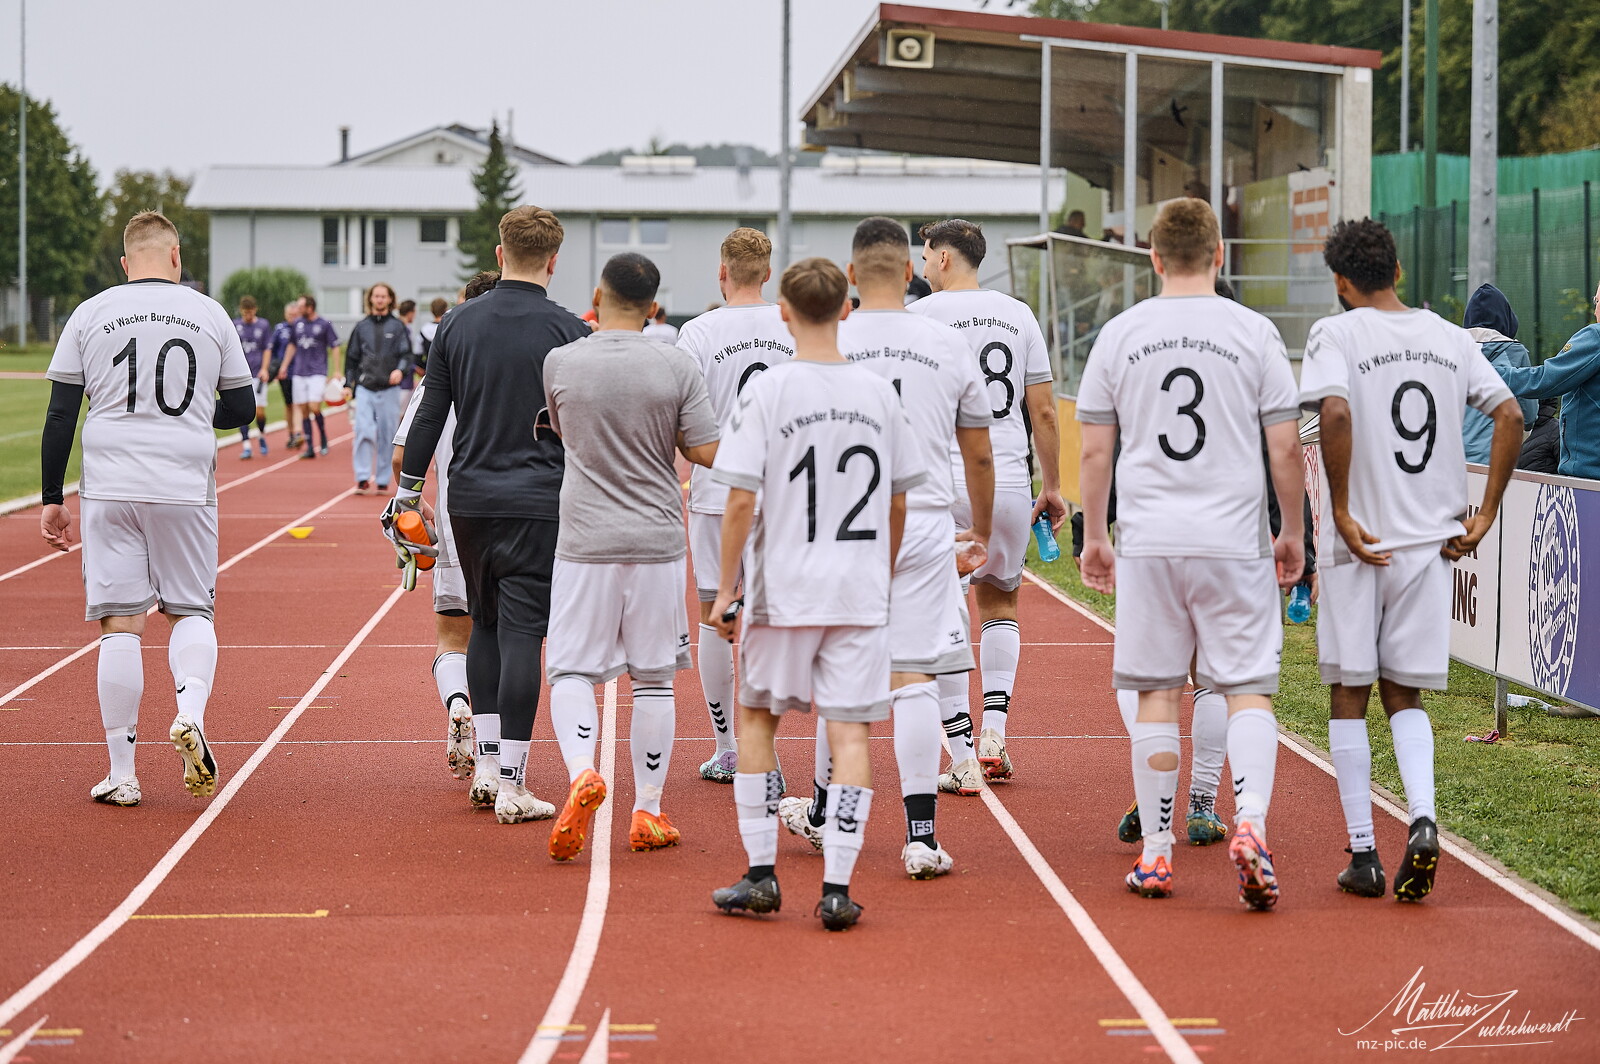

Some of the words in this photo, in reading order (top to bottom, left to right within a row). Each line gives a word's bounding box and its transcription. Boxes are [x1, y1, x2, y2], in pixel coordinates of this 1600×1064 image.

[103, 321, 116, 334] SV
[116, 314, 148, 328] Wacker
[150, 312, 201, 333] Burghausen
[950, 320, 970, 329] cker
[973, 317, 1019, 335] Burghausen
[714, 351, 725, 363] SV
[724, 341, 752, 356] Wacker
[754, 338, 794, 357] Burghause
[845, 348, 880, 363] Wacker
[884, 347, 939, 371] Burghausen
[1128, 352, 1141, 365] SV
[1142, 339, 1178, 356] Wacker
[1181, 337, 1240, 365] Burghausen
[1358, 361, 1371, 375] SV
[1371, 351, 1402, 368] Wacker
[1405, 350, 1457, 373] Burghausen
[112, 337, 197, 417] 10
[979, 341, 1014, 419] 8
[780, 422, 794, 438] SV
[795, 411, 828, 428] Wacker
[830, 408, 882, 435] Burghausen
[1158, 367, 1206, 461] 3
[1391, 380, 1436, 474] 9
[789, 445, 881, 542] 12
[1541, 531, 1564, 591] 100%
[914, 821, 932, 834] FS
